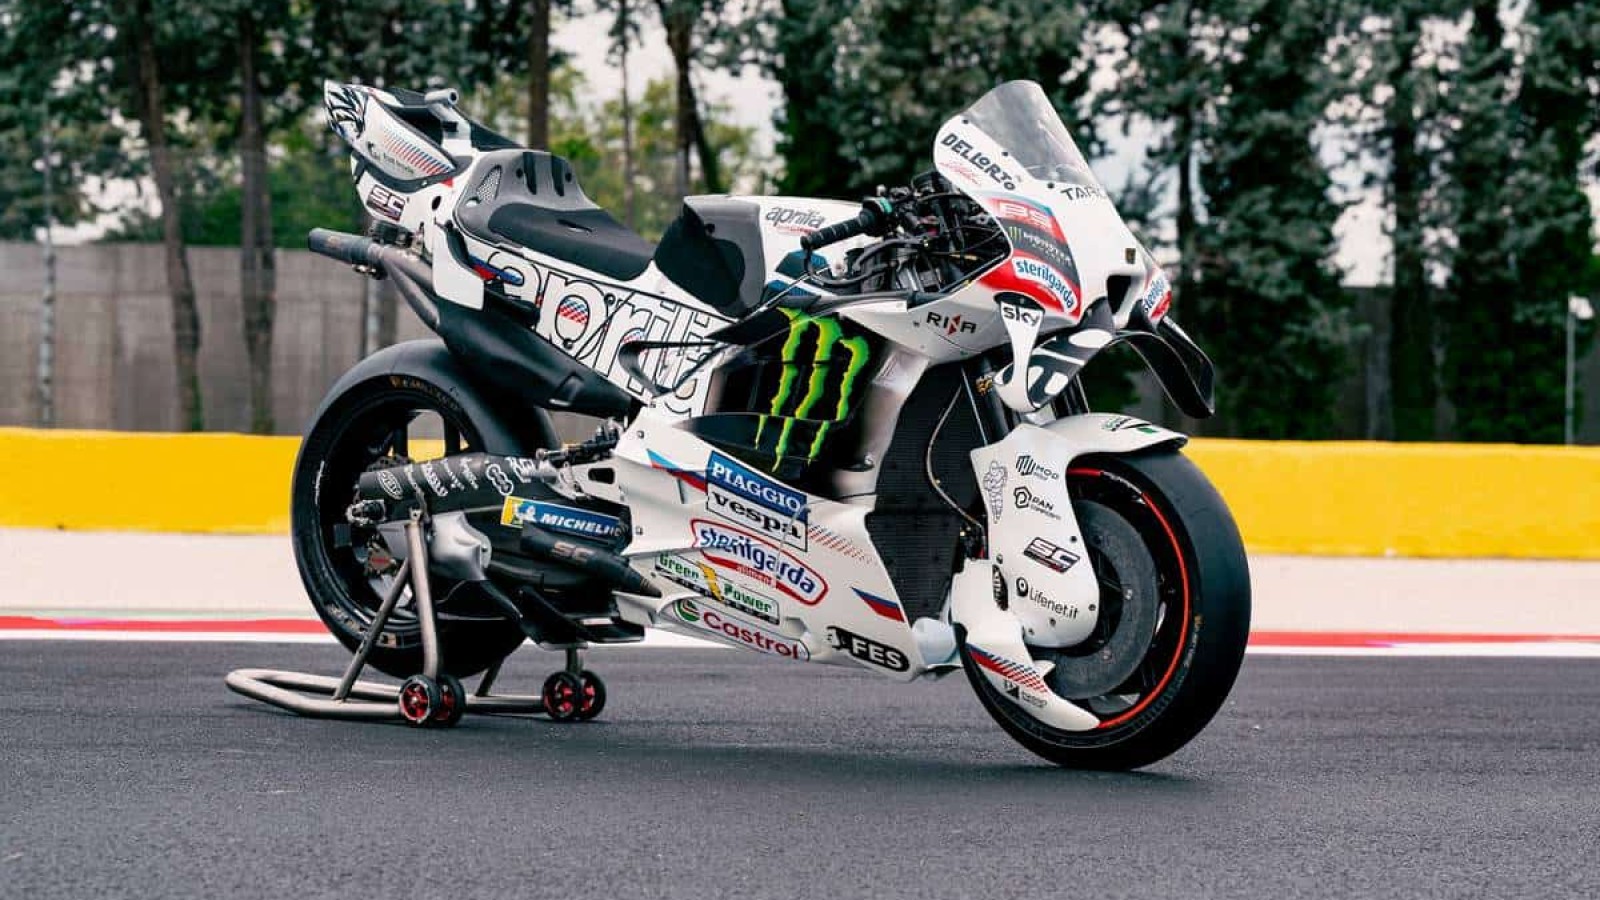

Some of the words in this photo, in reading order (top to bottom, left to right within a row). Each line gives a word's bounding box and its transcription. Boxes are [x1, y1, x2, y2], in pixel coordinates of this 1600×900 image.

[1014, 260, 1075, 309] sterilgarda
[1002, 305, 1039, 327] sky
[711, 461, 801, 509] PIAGGIO
[711, 492, 802, 538] vespa
[659, 552, 700, 579] Green
[723, 583, 773, 612] Power
[699, 528, 816, 594] sterilgarda
[1028, 588, 1080, 619] Lifenet.it
[703, 611, 799, 661] Castrol
